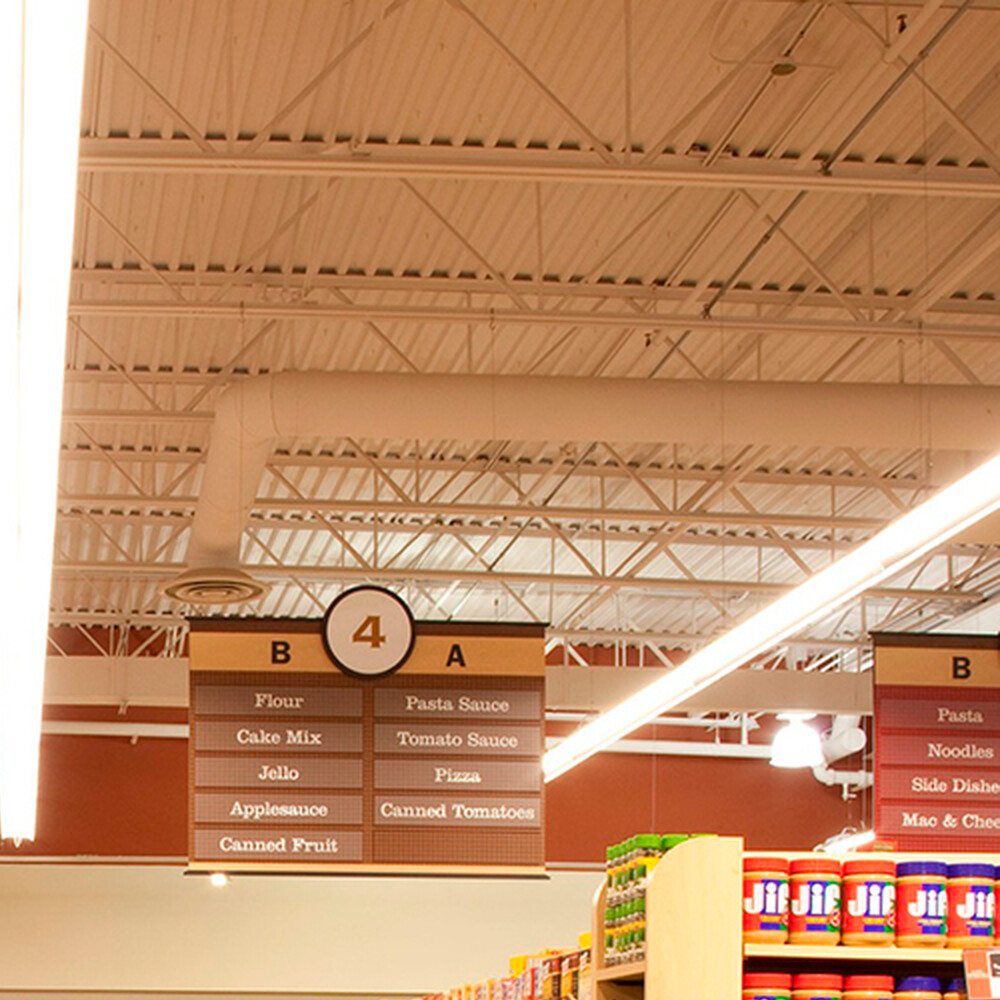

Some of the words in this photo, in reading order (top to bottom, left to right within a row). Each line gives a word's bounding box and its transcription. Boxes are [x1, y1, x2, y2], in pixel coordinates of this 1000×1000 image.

[352, 616, 386, 648] 4
[271, 641, 291, 664] B
[446, 644, 466, 667] A
[952, 656, 971, 679] B
[254, 693, 304, 708] Flour
[406, 696, 453, 712] Pasta
[458, 696, 510, 712] Sauce
[936, 707, 984, 723] Pasta
[236, 729, 281, 745] Cake
[286, 730, 322, 745] Mix
[397, 731, 462, 747] Tomato
[467, 732, 518, 748] Sauce
[927, 743, 994, 759] Noodles
[258, 765, 300, 781] Jello
[434, 768, 481, 783] Pizza
[911, 777, 948, 792] Side
[229, 801, 328, 820] Applesauce
[380, 803, 446, 819] Canned
[452, 804, 535, 820] Tomatoes
[902, 812, 938, 828] Mac
[942, 814, 957, 828] &
[219, 837, 286, 853] Canned
[291, 838, 338, 854] Fruit
[744, 882, 790, 914] Jif
[792, 884, 840, 916] Jif
[847, 883, 896, 916] Jif
